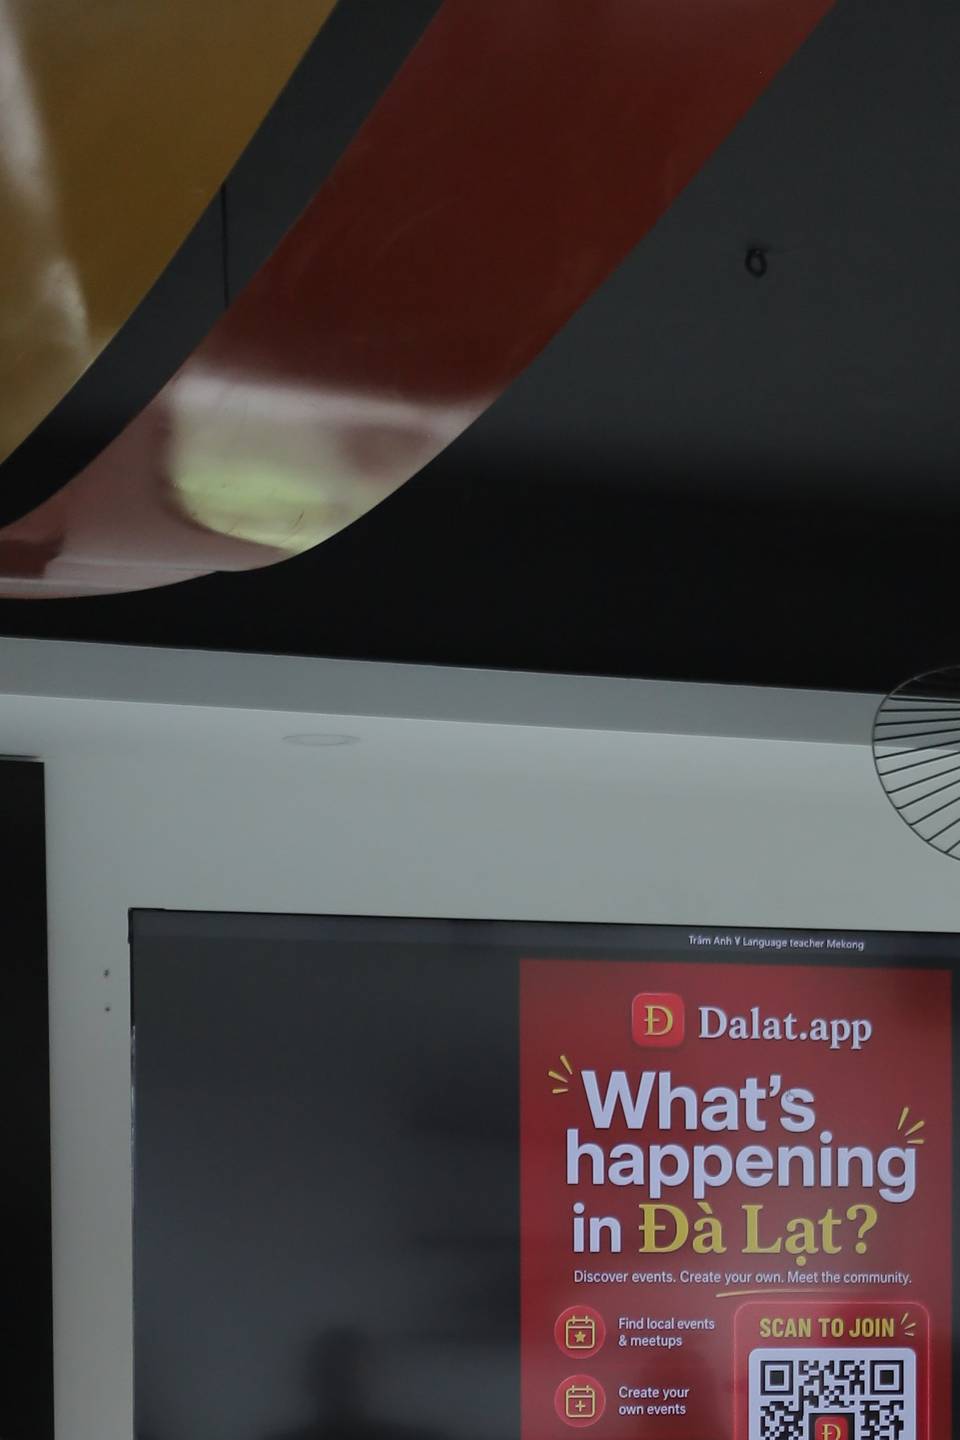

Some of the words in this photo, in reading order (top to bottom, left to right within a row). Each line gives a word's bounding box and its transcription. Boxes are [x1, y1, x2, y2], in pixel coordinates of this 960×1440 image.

[714, 937, 731, 946] Anh
[743, 937, 788, 949] Language
[790, 938, 824, 948] teacher
[827, 939, 864, 951] Mekong
[698, 1007, 872, 1050] Dalat.app
[566, 1129, 917, 1203] happening
[573, 1202, 621, 1253] in
[638, 1202, 726, 1254] Đà
[741, 1204, 878, 1266] Lạt?
[573, 1270, 628, 1283] Discover
[632, 1271, 676, 1283] events.
[680, 1270, 722, 1284] Create
[724, 1273, 752, 1287] your
[755, 1273, 784, 1284] own.
[787, 1270, 818, 1284] Meet
[821, 1271, 840, 1284] the
[843, 1271, 912, 1287] community.
[618, 1317, 643, 1330] Find
[646, 1317, 674, 1330] local
[677, 1319, 715, 1330] events
[759, 1317, 812, 1338] SCAN
[818, 1318, 844, 1339] TO
[849, 1318, 894, 1339] JOIN
[618, 1335, 627, 1347] &
[630, 1335, 682, 1349] meetups
[618, 1386, 659, 1399] Create
[662, 1388, 689, 1402] your
[618, 1405, 643, 1415] own
[647, 1404, 686, 1415] events
